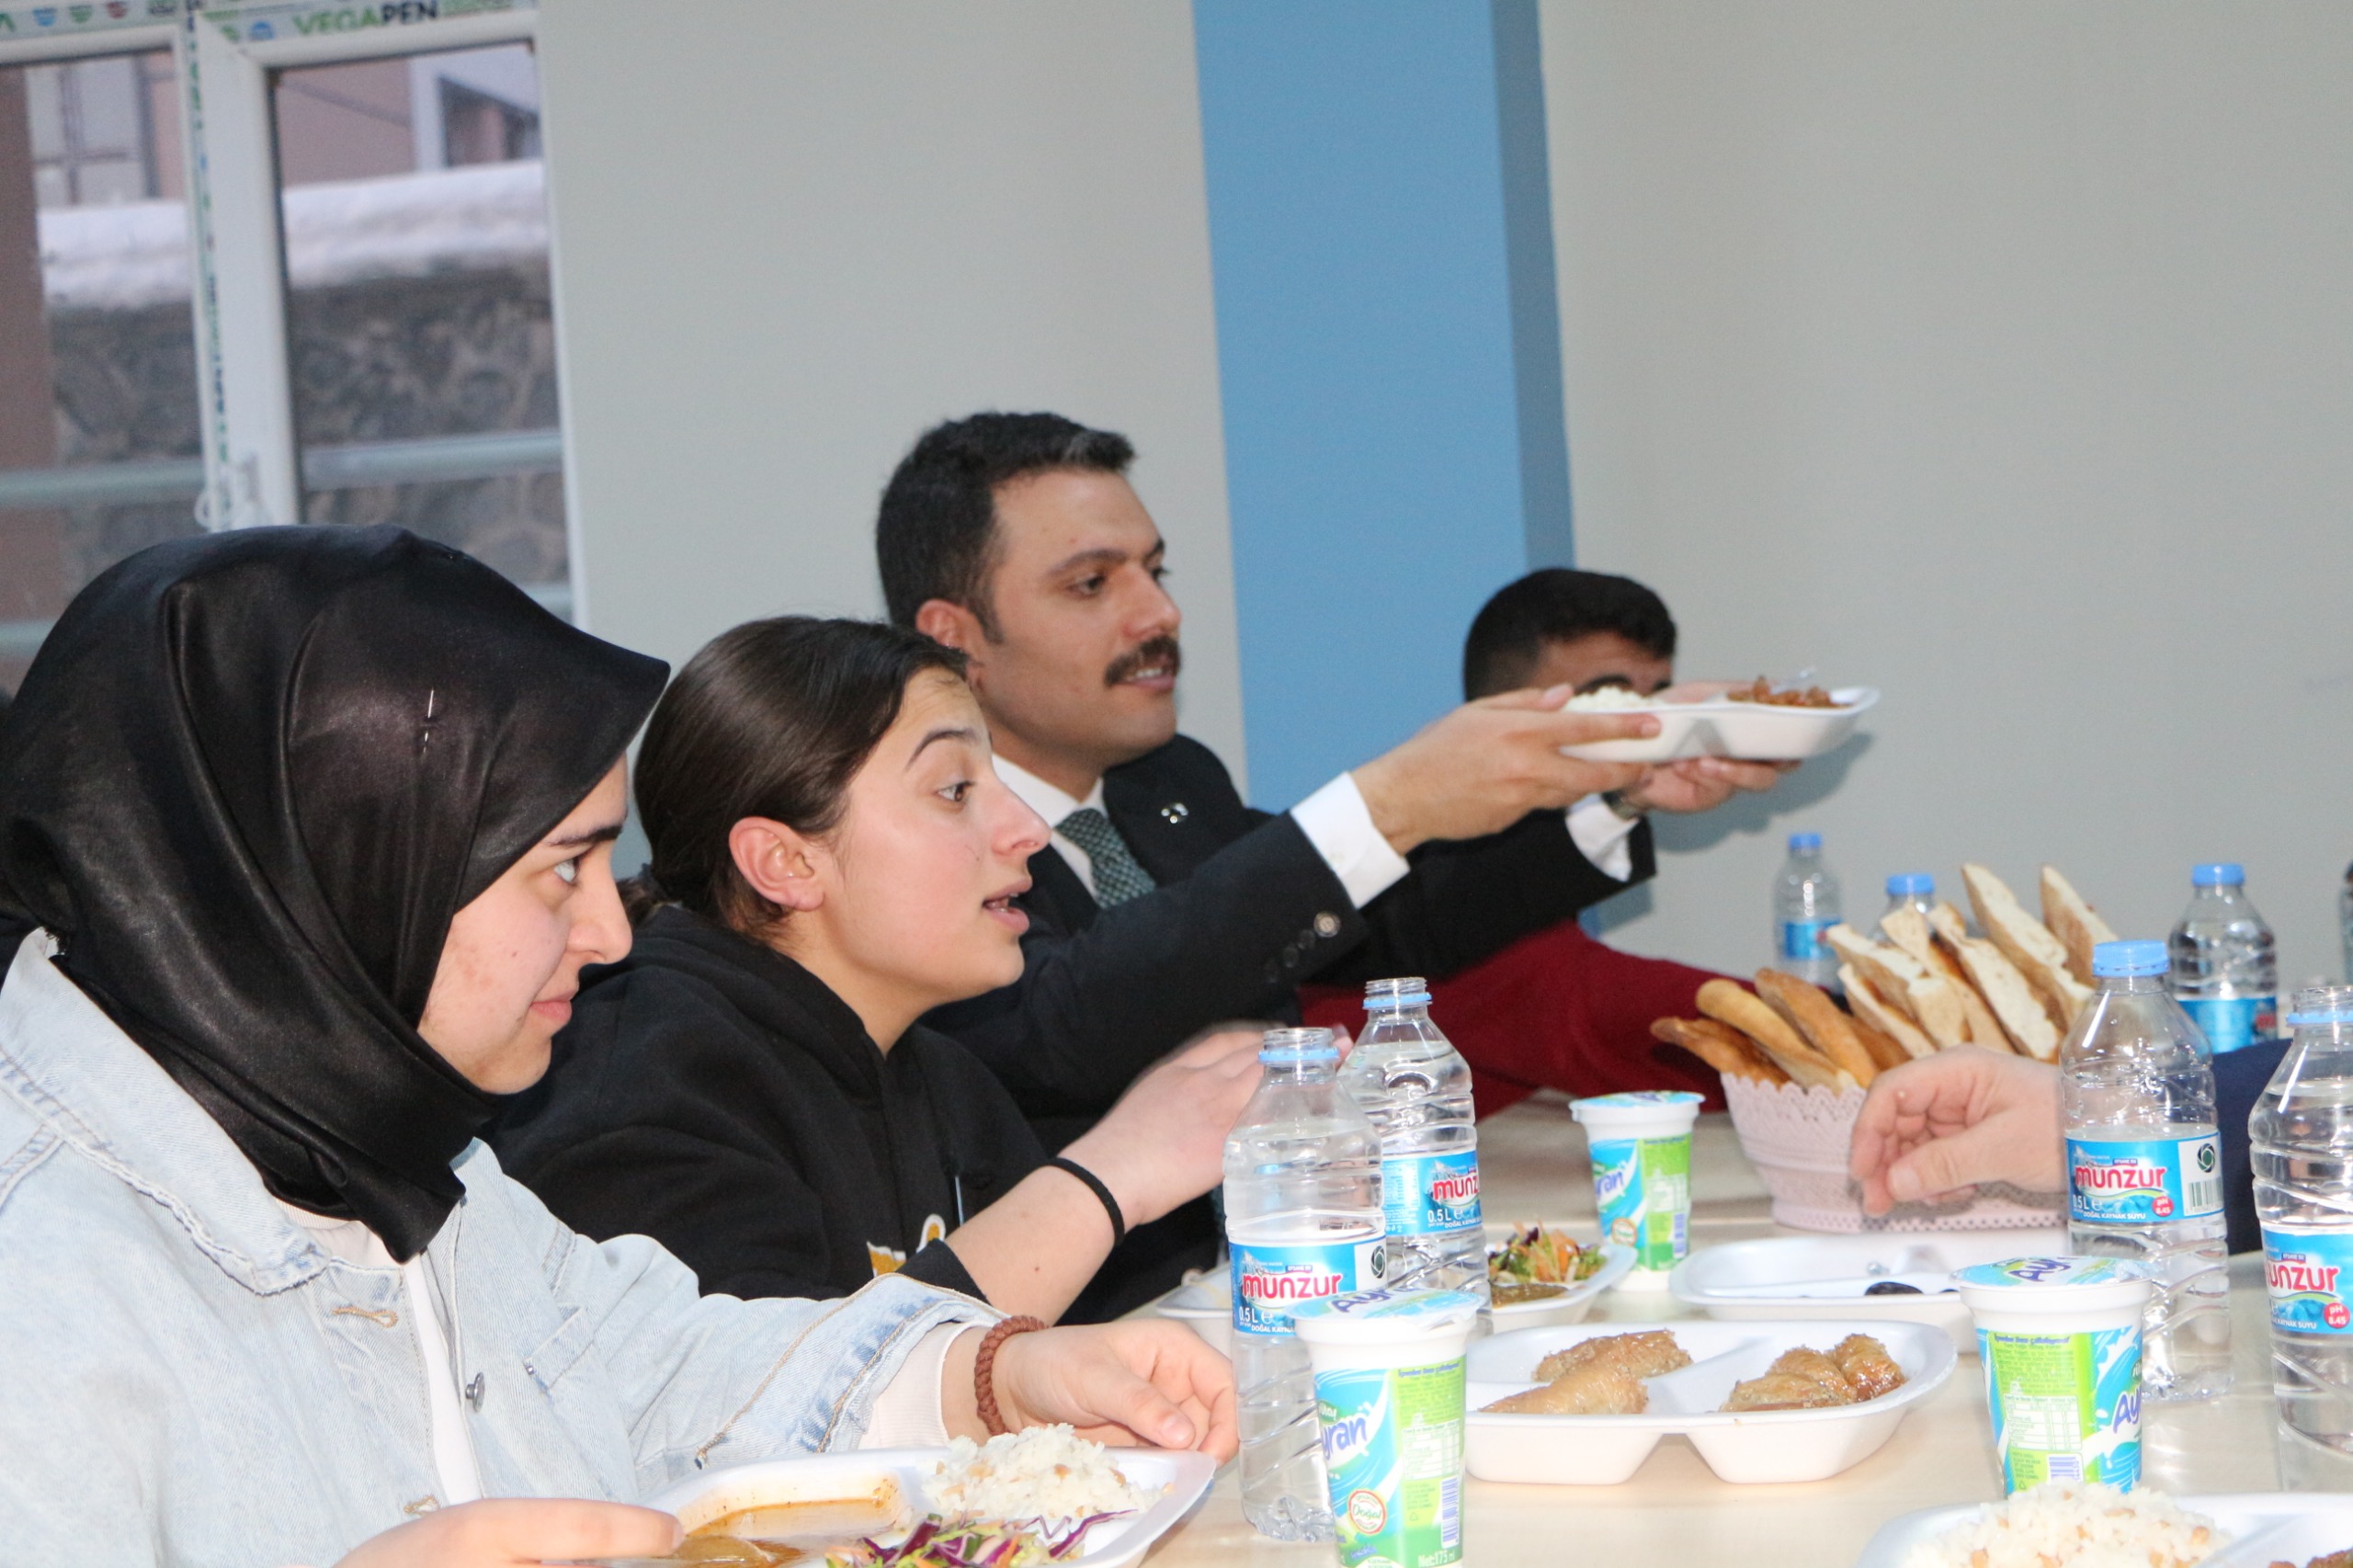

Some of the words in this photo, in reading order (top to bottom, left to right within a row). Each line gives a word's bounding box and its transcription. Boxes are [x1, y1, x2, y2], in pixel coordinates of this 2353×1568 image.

[292, 0, 438, 36] VEGAPEN
[2075, 1166, 2165, 1188] munzur
[1243, 1274, 1342, 1299] munzur
[2329, 1305, 2343, 1315] pH
[2298, 1321, 2317, 1330] SUYU
